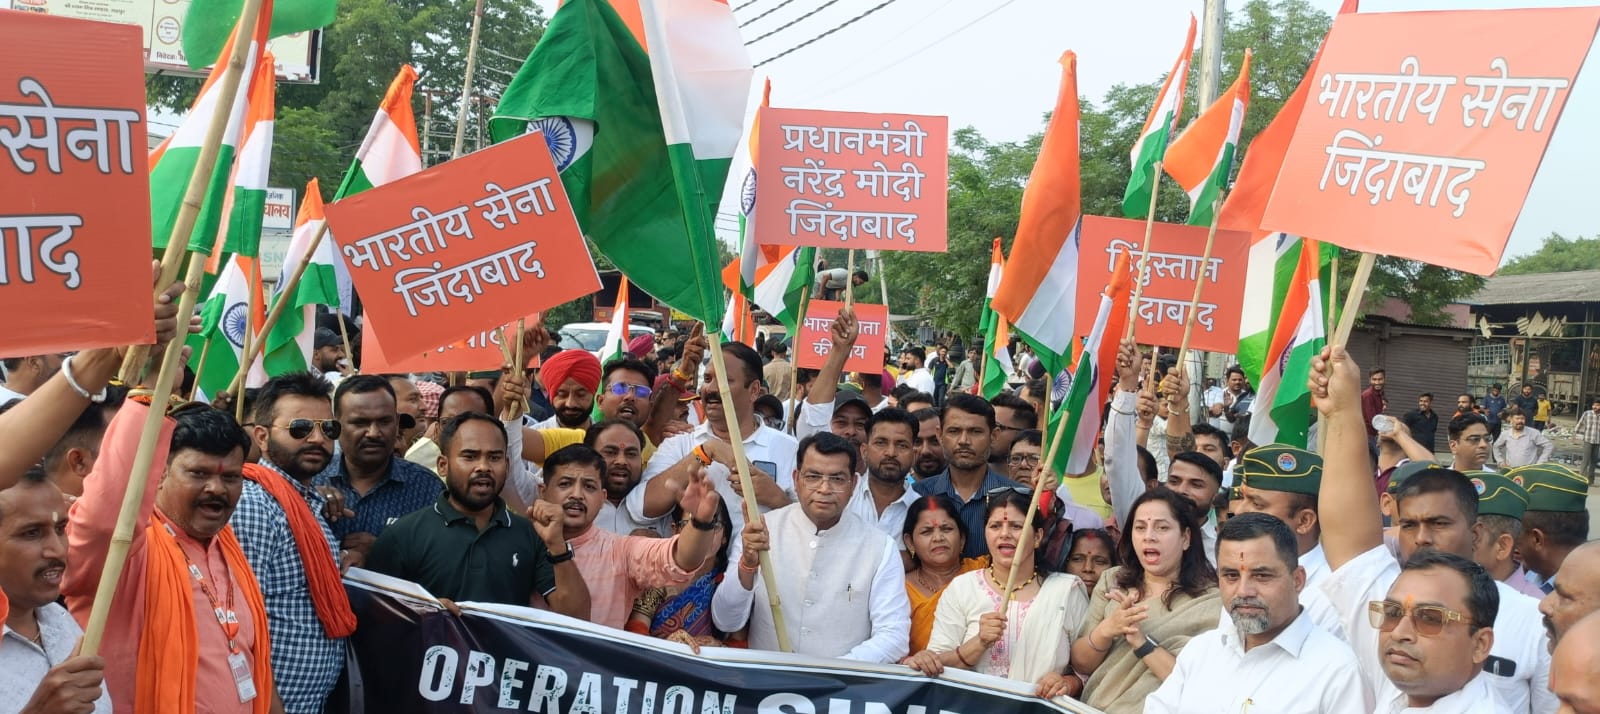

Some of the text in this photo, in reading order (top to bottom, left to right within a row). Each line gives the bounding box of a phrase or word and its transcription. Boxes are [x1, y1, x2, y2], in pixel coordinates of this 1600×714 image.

[1318, 56, 1569, 132] भारतीय सेना
[0, 76, 140, 174] सेना
[780, 120, 928, 158] प्रधानमंत्री
[780, 158, 925, 202] नरेंद्र मोदी
[1318, 128, 1486, 218] जिंदाबाद
[343, 177, 556, 271] भारतीय सेना
[784, 199, 919, 244] जिंदाबाद
[393, 240, 545, 317] जिंदाबाद
[1105, 239, 1224, 286] िंदुस्तान
[803, 317, 836, 332] भार
